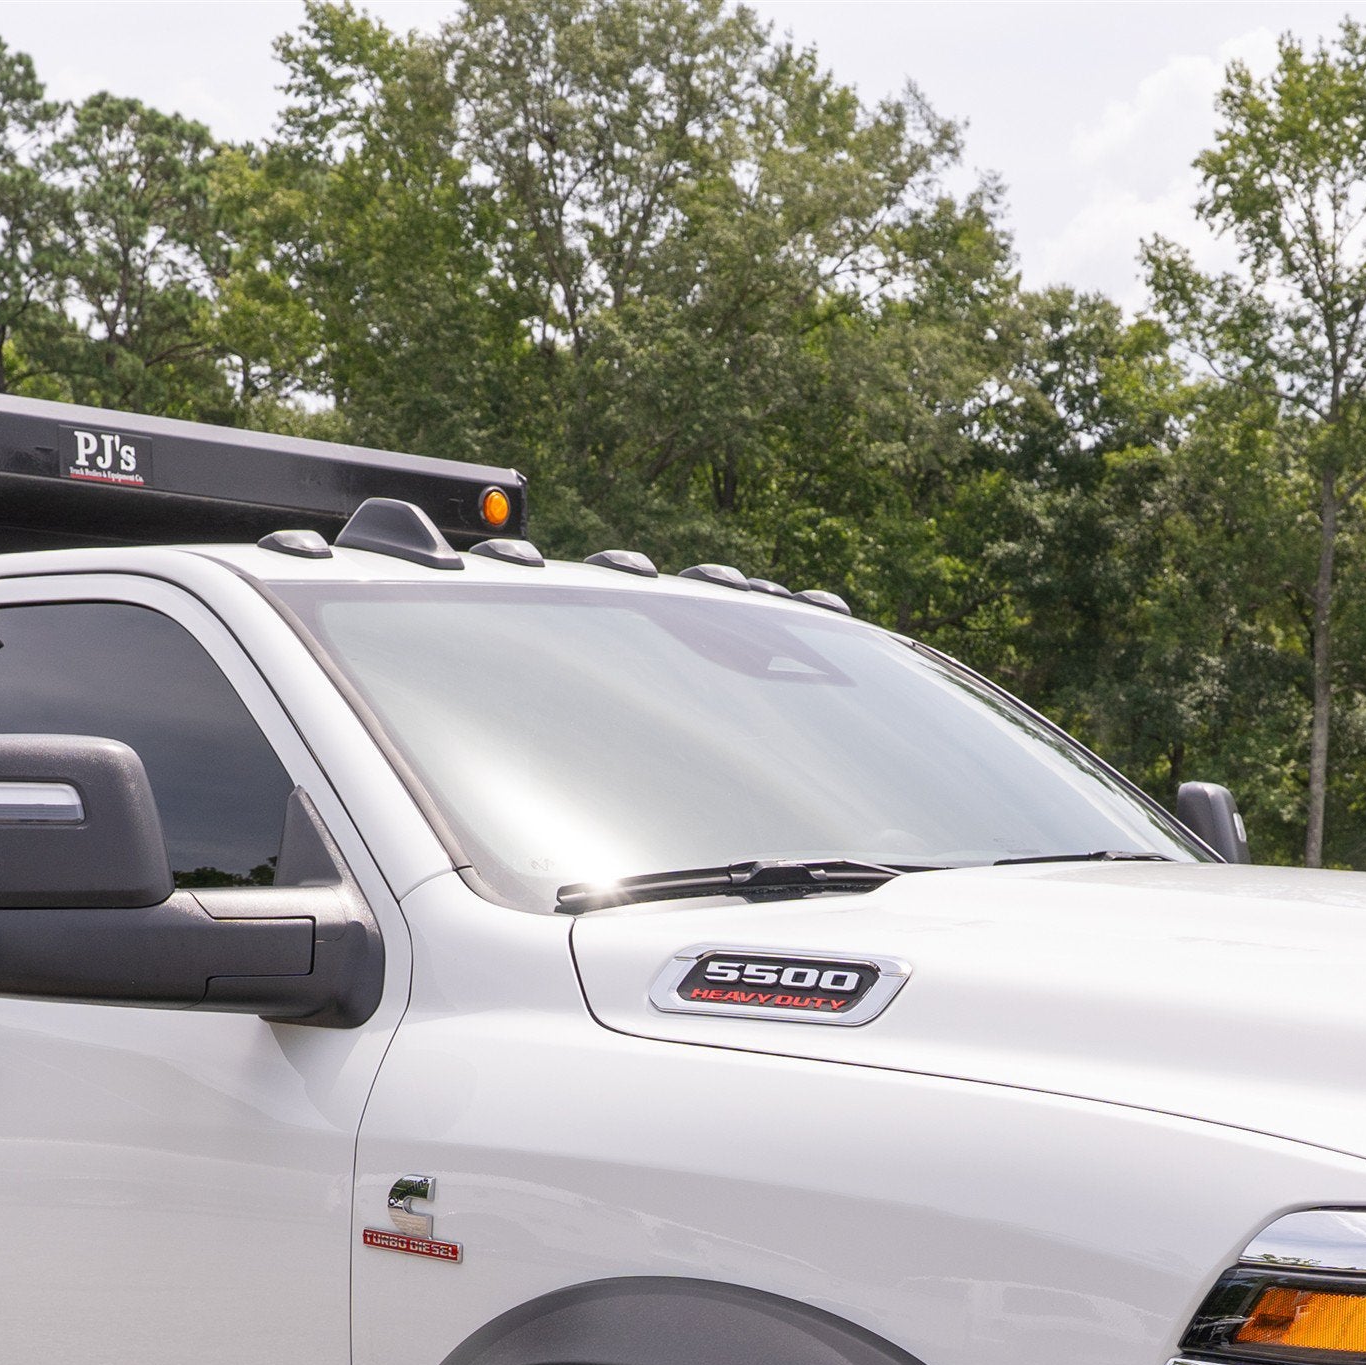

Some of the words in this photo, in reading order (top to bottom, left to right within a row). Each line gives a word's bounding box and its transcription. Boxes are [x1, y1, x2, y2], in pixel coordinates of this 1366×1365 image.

[73, 430, 137, 472] PJ's
[704, 960, 862, 992] 5500
[690, 987, 772, 1005] HEAVY
[774, 995, 848, 1011] DUTY
[365, 1231, 407, 1249] TURBO
[410, 1240, 457, 1258] DIESEL
